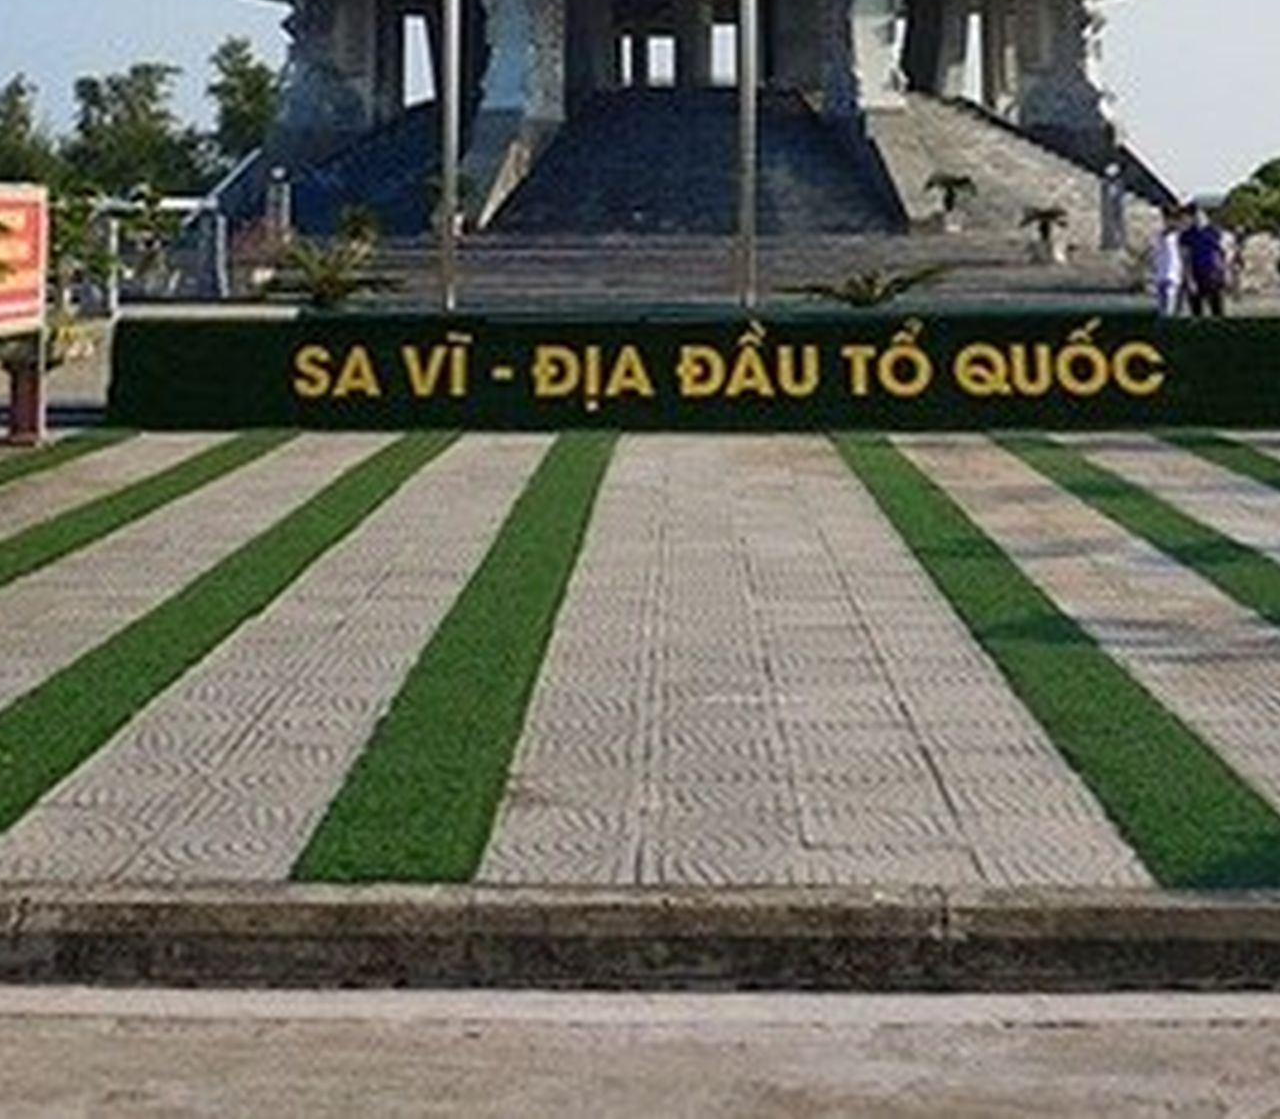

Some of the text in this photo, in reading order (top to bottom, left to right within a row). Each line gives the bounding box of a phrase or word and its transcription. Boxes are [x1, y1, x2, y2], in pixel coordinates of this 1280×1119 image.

[294, 346, 381, 397] SA
[402, 332, 472, 397] VĨ
[531, 345, 653, 412] ĐỊA
[675, 320, 819, 397] ĐẦU
[841, 318, 933, 397] TỔ
[953, 318, 1165, 397] QUỐC
